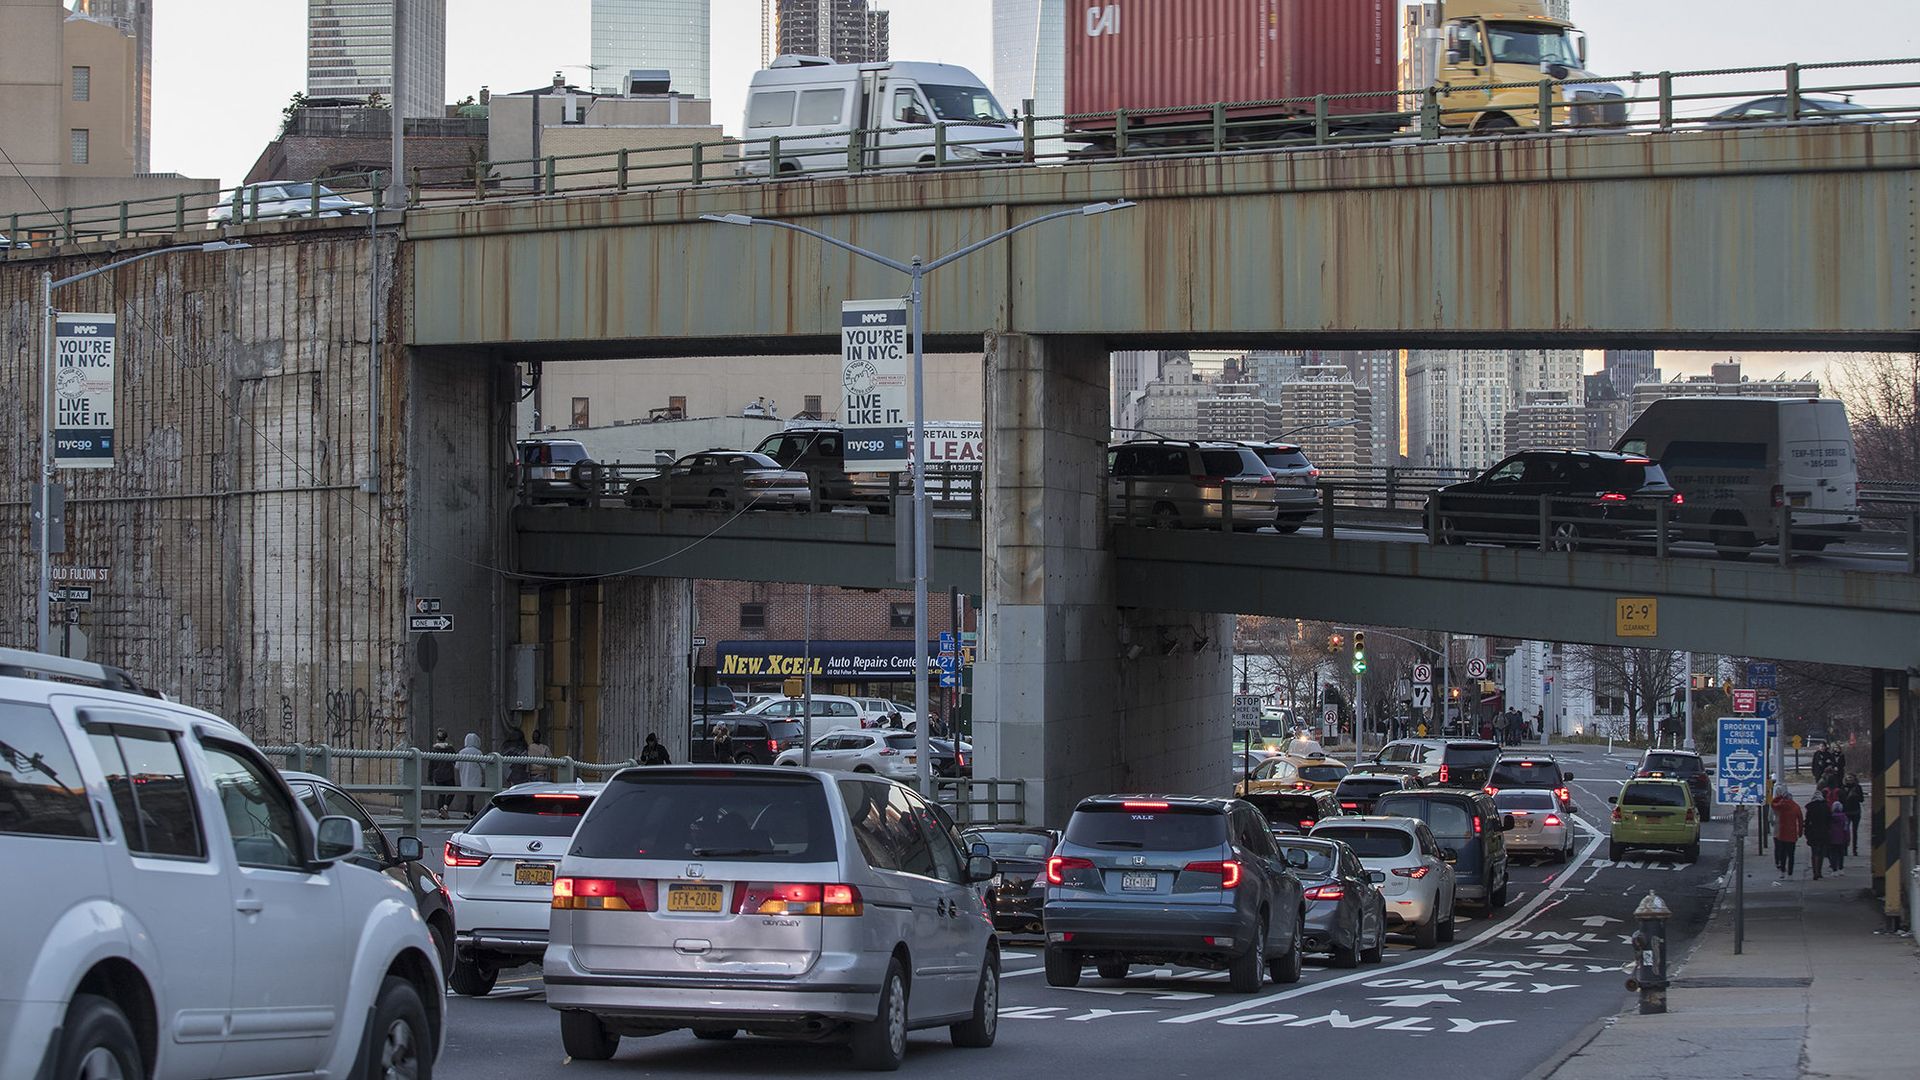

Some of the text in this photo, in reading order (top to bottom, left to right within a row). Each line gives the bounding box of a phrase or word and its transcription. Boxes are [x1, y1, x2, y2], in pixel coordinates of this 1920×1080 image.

[1086, 4, 1121, 37] CAI
[861, 313, 888, 323] NYC
[73, 325, 98, 334] NYC
[846, 329, 903, 345] YOU'RE
[59, 340, 111, 354] YOU'RE
[847, 345, 903, 360] IN NYC.
[59, 354, 110, 368] IN NYC.
[59, 398, 90, 412] LIVE
[847, 394, 881, 409] LIVE
[58, 412, 109, 426] LIKE IT.
[847, 409, 903, 425] LIKE IT.
[923, 430, 957, 439] RETAIL
[58, 439, 92, 453] nycgo
[847, 440, 884, 452] nycgo
[1825, 448, 1847, 457] SERVICE
[1717, 475, 1750, 485] SERVICE
[52, 568, 108, 580] OLD FULTON ST
[416, 619, 428, 627] ONE
[722, 654, 823, 675] NEW XCELL
[827, 656, 850, 668] Auto
[853, 656, 888, 671] Repairs
[890, 656, 916, 668] Cente
[1236, 697, 1259, 706] STOP
[1361, 978, 1583, 994] ONLY
[1216, 1010, 1518, 1033] ONLY
